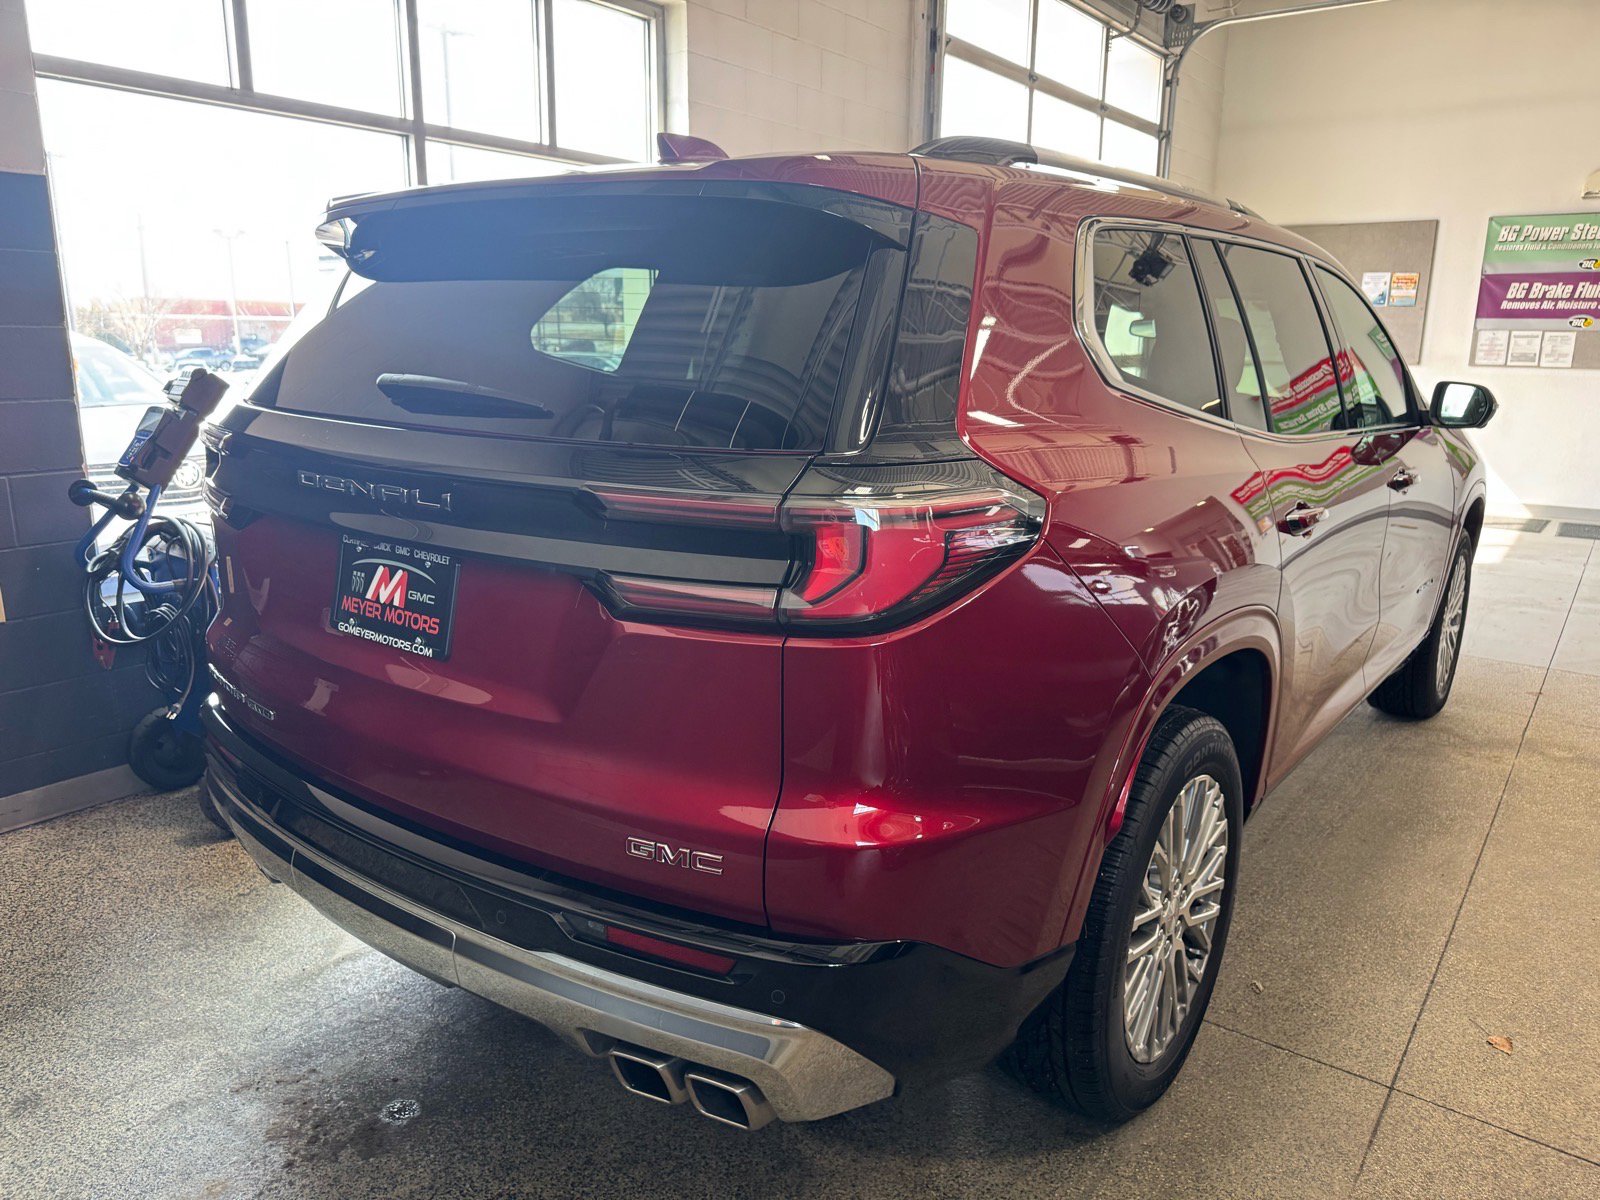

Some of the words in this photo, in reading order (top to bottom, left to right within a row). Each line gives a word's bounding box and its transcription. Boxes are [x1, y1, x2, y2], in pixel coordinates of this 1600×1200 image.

[1497, 224, 1521, 242] BG
[1520, 224, 1570, 242] Power
[1494, 243, 1523, 252] Restores
[1506, 282, 1529, 299] BG
[1528, 282, 1574, 299] Brake
[1500, 300, 1541, 310] Removes
[1540, 300, 1556, 311] Air,
[1555, 299, 1598, 310] Moisture
[395, 545, 410, 556] GMC
[413, 549, 451, 565] CHEVROLET
[408, 589, 436, 605] GMC
[341, 595, 382, 620] MEYER
[384, 608, 440, 635] MOTORS
[338, 622, 433, 658] GOMEYERMOTORS.COM
[625, 836, 724, 875] GMC
